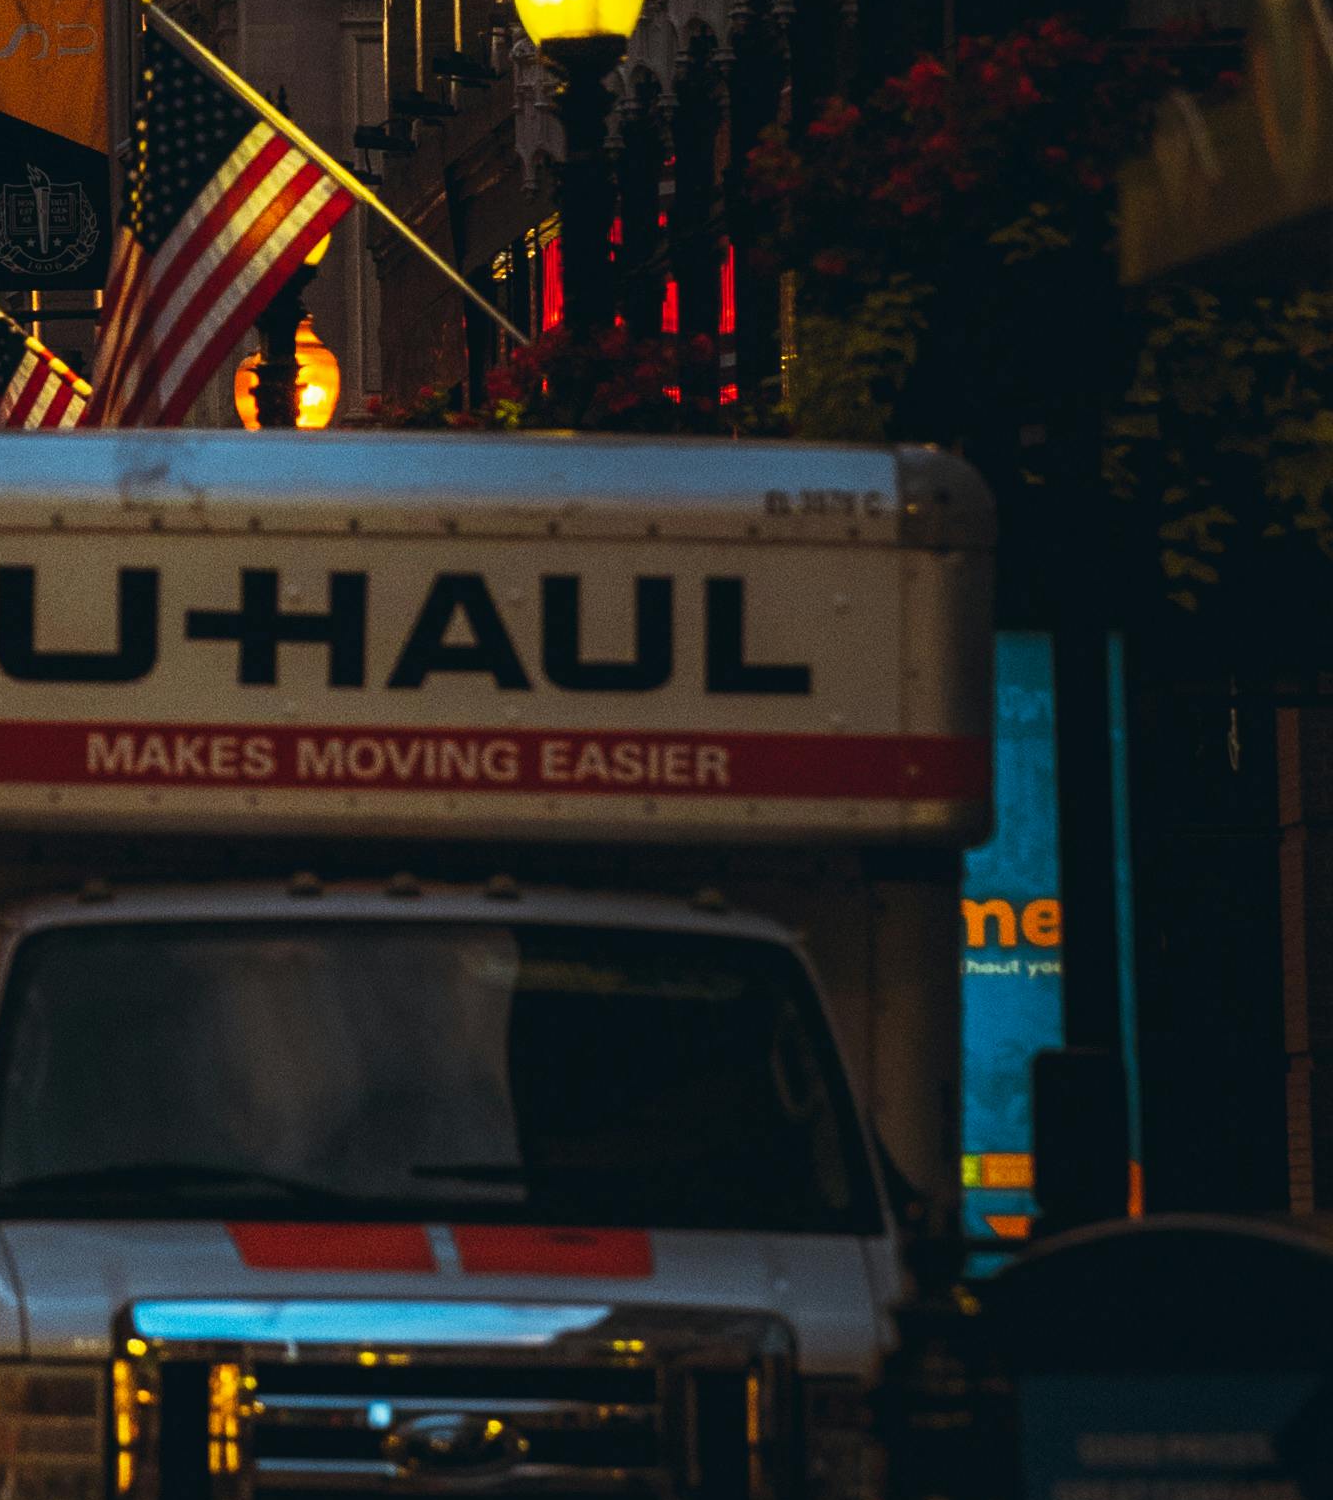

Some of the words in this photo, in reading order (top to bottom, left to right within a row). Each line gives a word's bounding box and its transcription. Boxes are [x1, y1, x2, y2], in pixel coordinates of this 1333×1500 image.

[86, 733, 276, 782] MAKES
[296, 735, 522, 784] MOVING
[539, 739, 732, 788] EASIER
